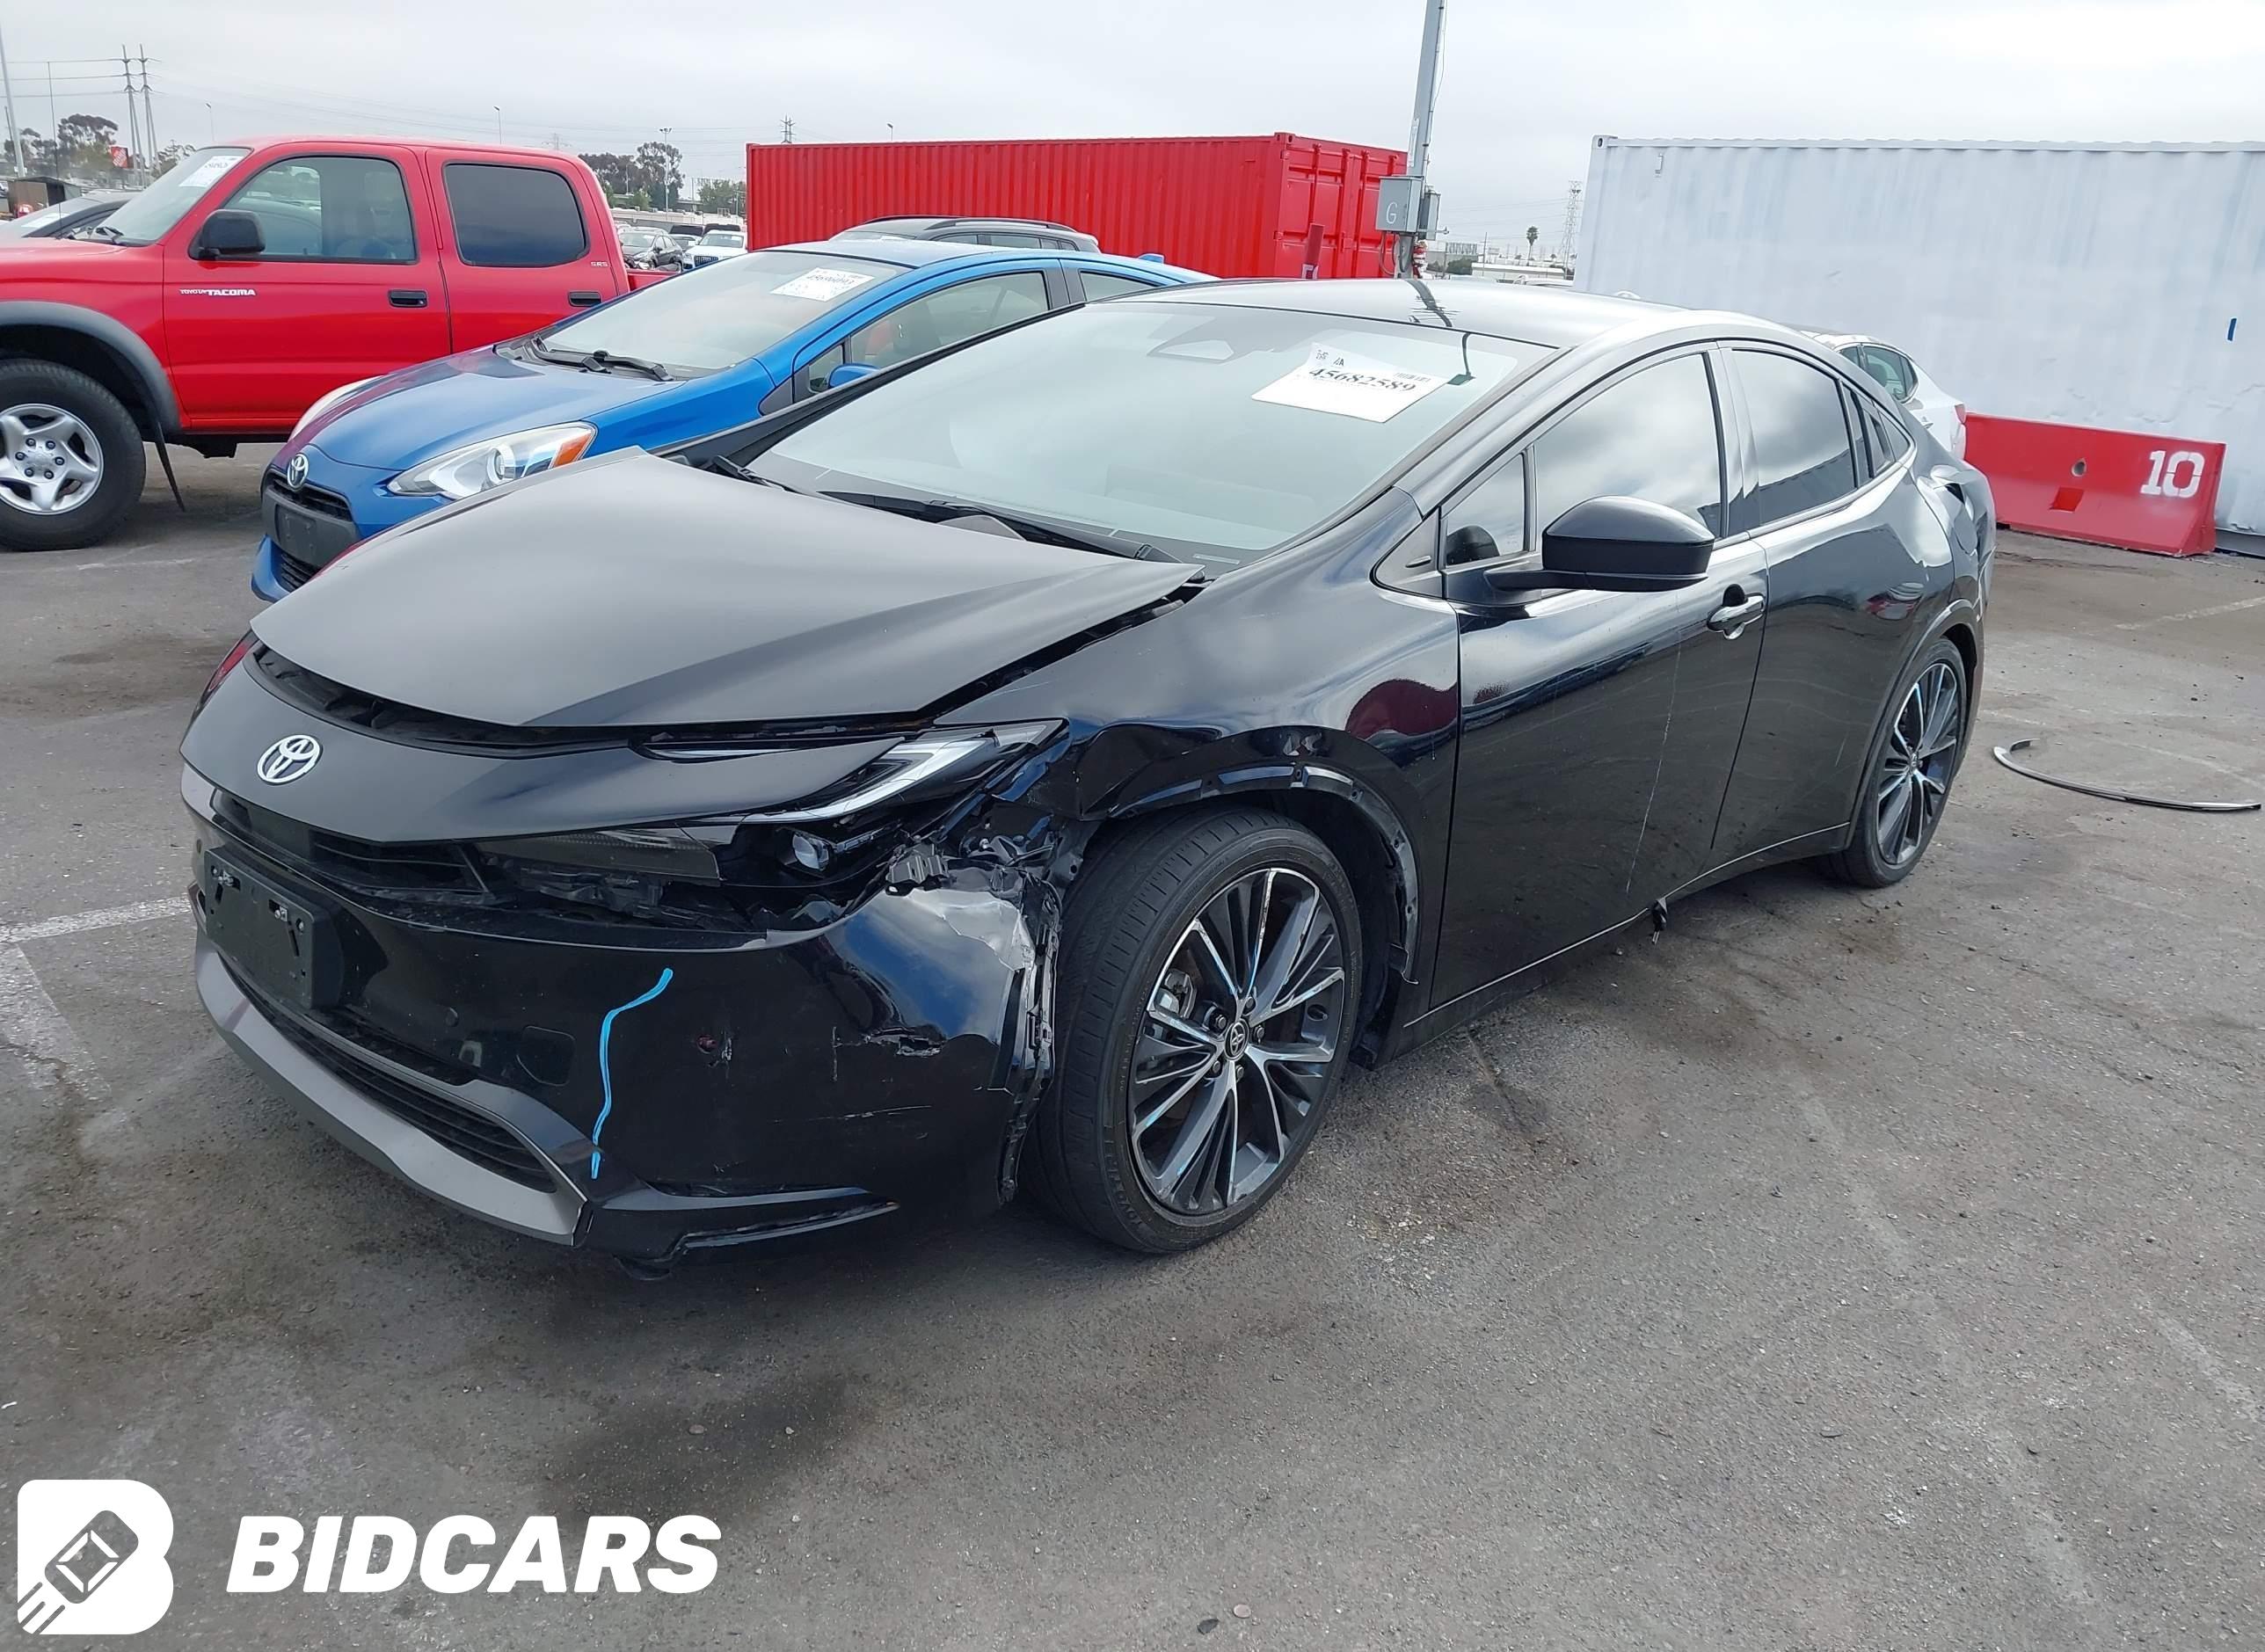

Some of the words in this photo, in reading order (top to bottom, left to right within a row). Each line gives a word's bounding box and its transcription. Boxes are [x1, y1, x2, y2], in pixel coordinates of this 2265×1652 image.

[1386, 201, 1398, 224] G
[1308, 368, 1417, 392] 45682589
[2139, 449, 2205, 499] 10
